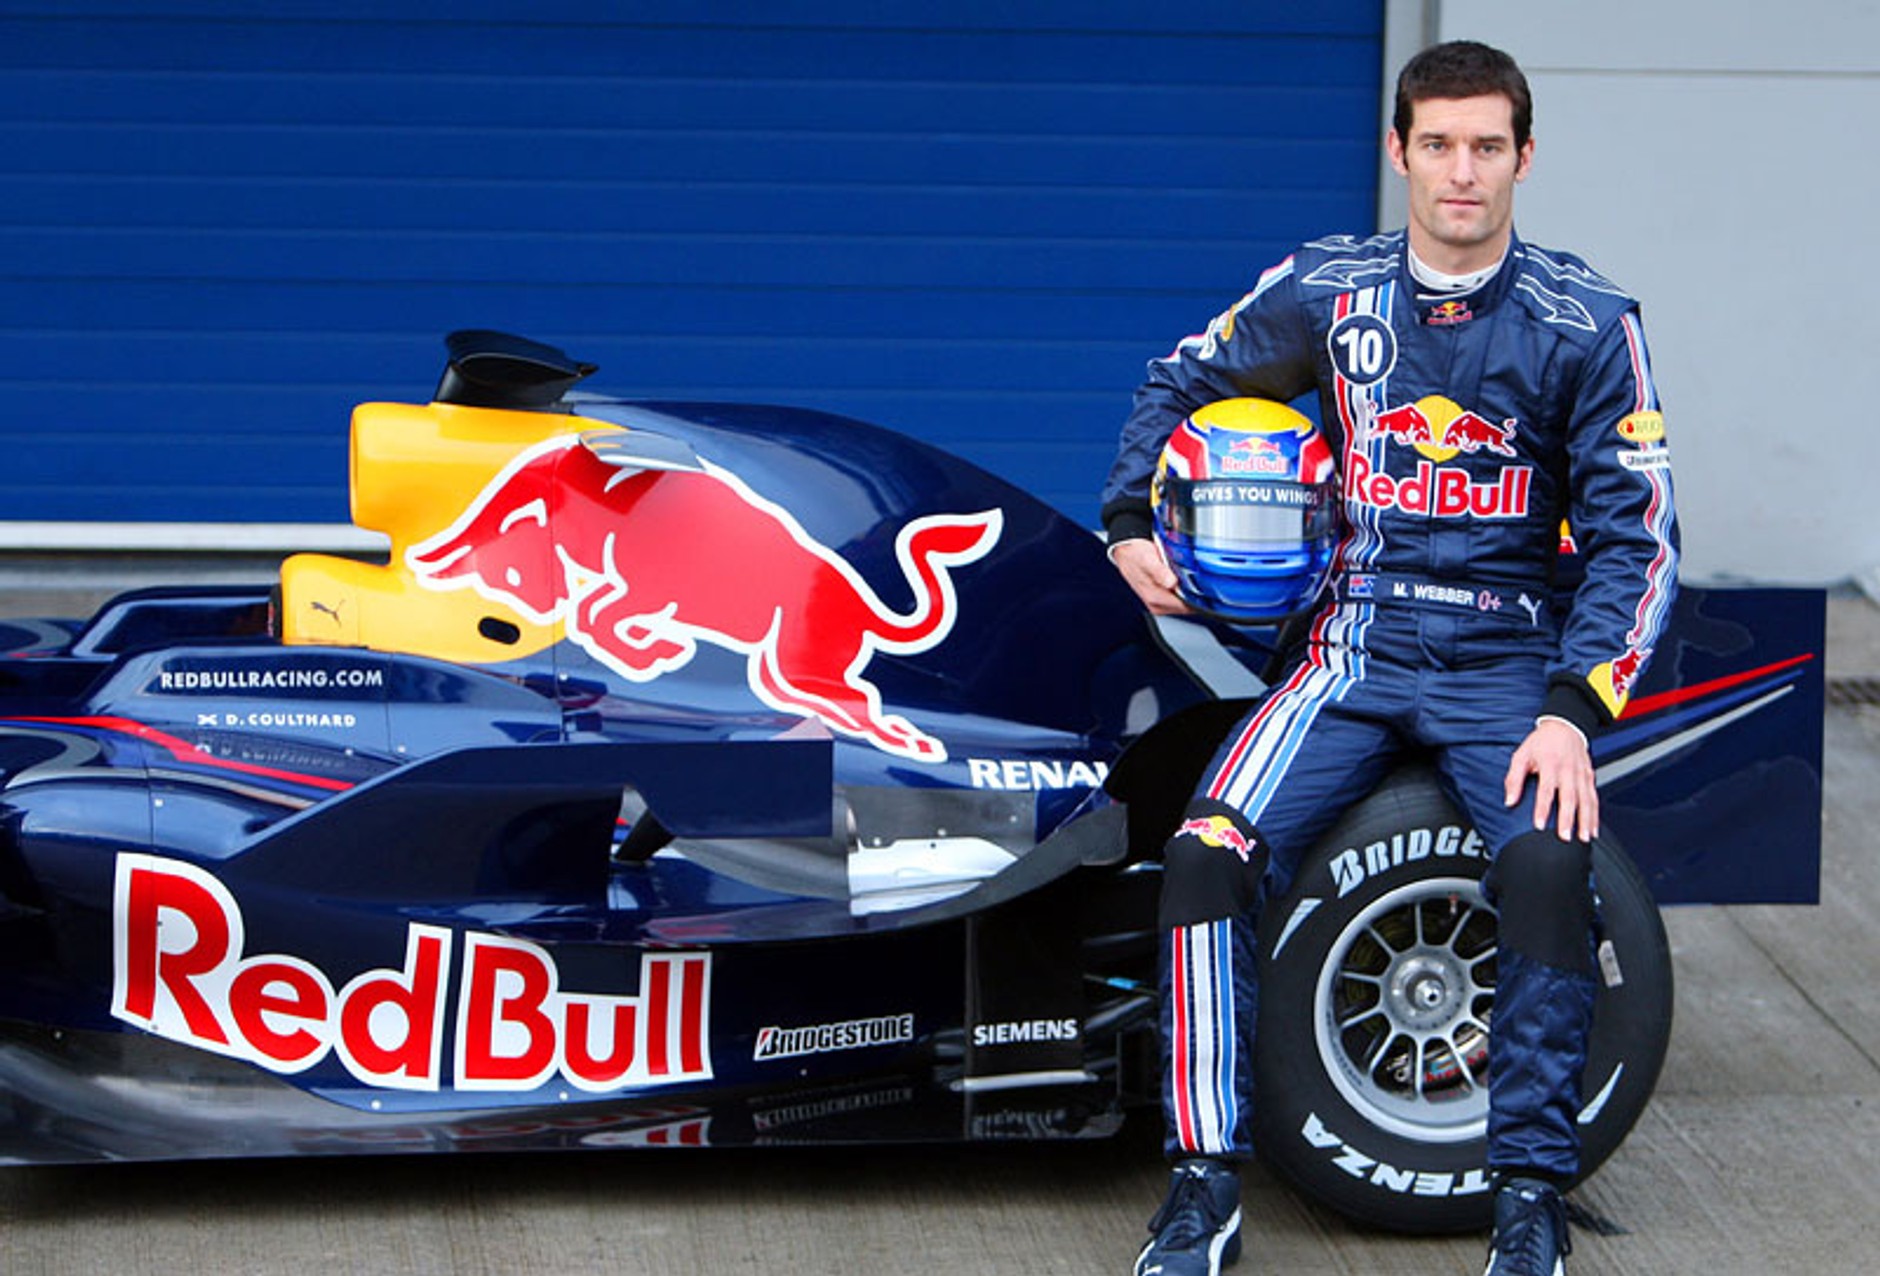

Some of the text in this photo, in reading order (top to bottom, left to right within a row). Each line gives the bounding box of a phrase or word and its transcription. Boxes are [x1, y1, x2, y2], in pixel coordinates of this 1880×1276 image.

[1336, 326, 1383, 375] 10
[1191, 486, 1233, 502] GIVES
[1238, 488, 1271, 503] YOU
[1344, 449, 1533, 518] Red Bull
[1413, 584, 1475, 606] WEBBER
[160, 669, 383, 689] REDBULLRACING.COM
[247, 713, 356, 727] COULTHARD
[110, 851, 714, 1091] Red Bull
[754, 1013, 914, 1061] BRIDGESTONE
[973, 1018, 1079, 1047] SIEMENS
[1301, 1111, 1500, 1197] TENZA
